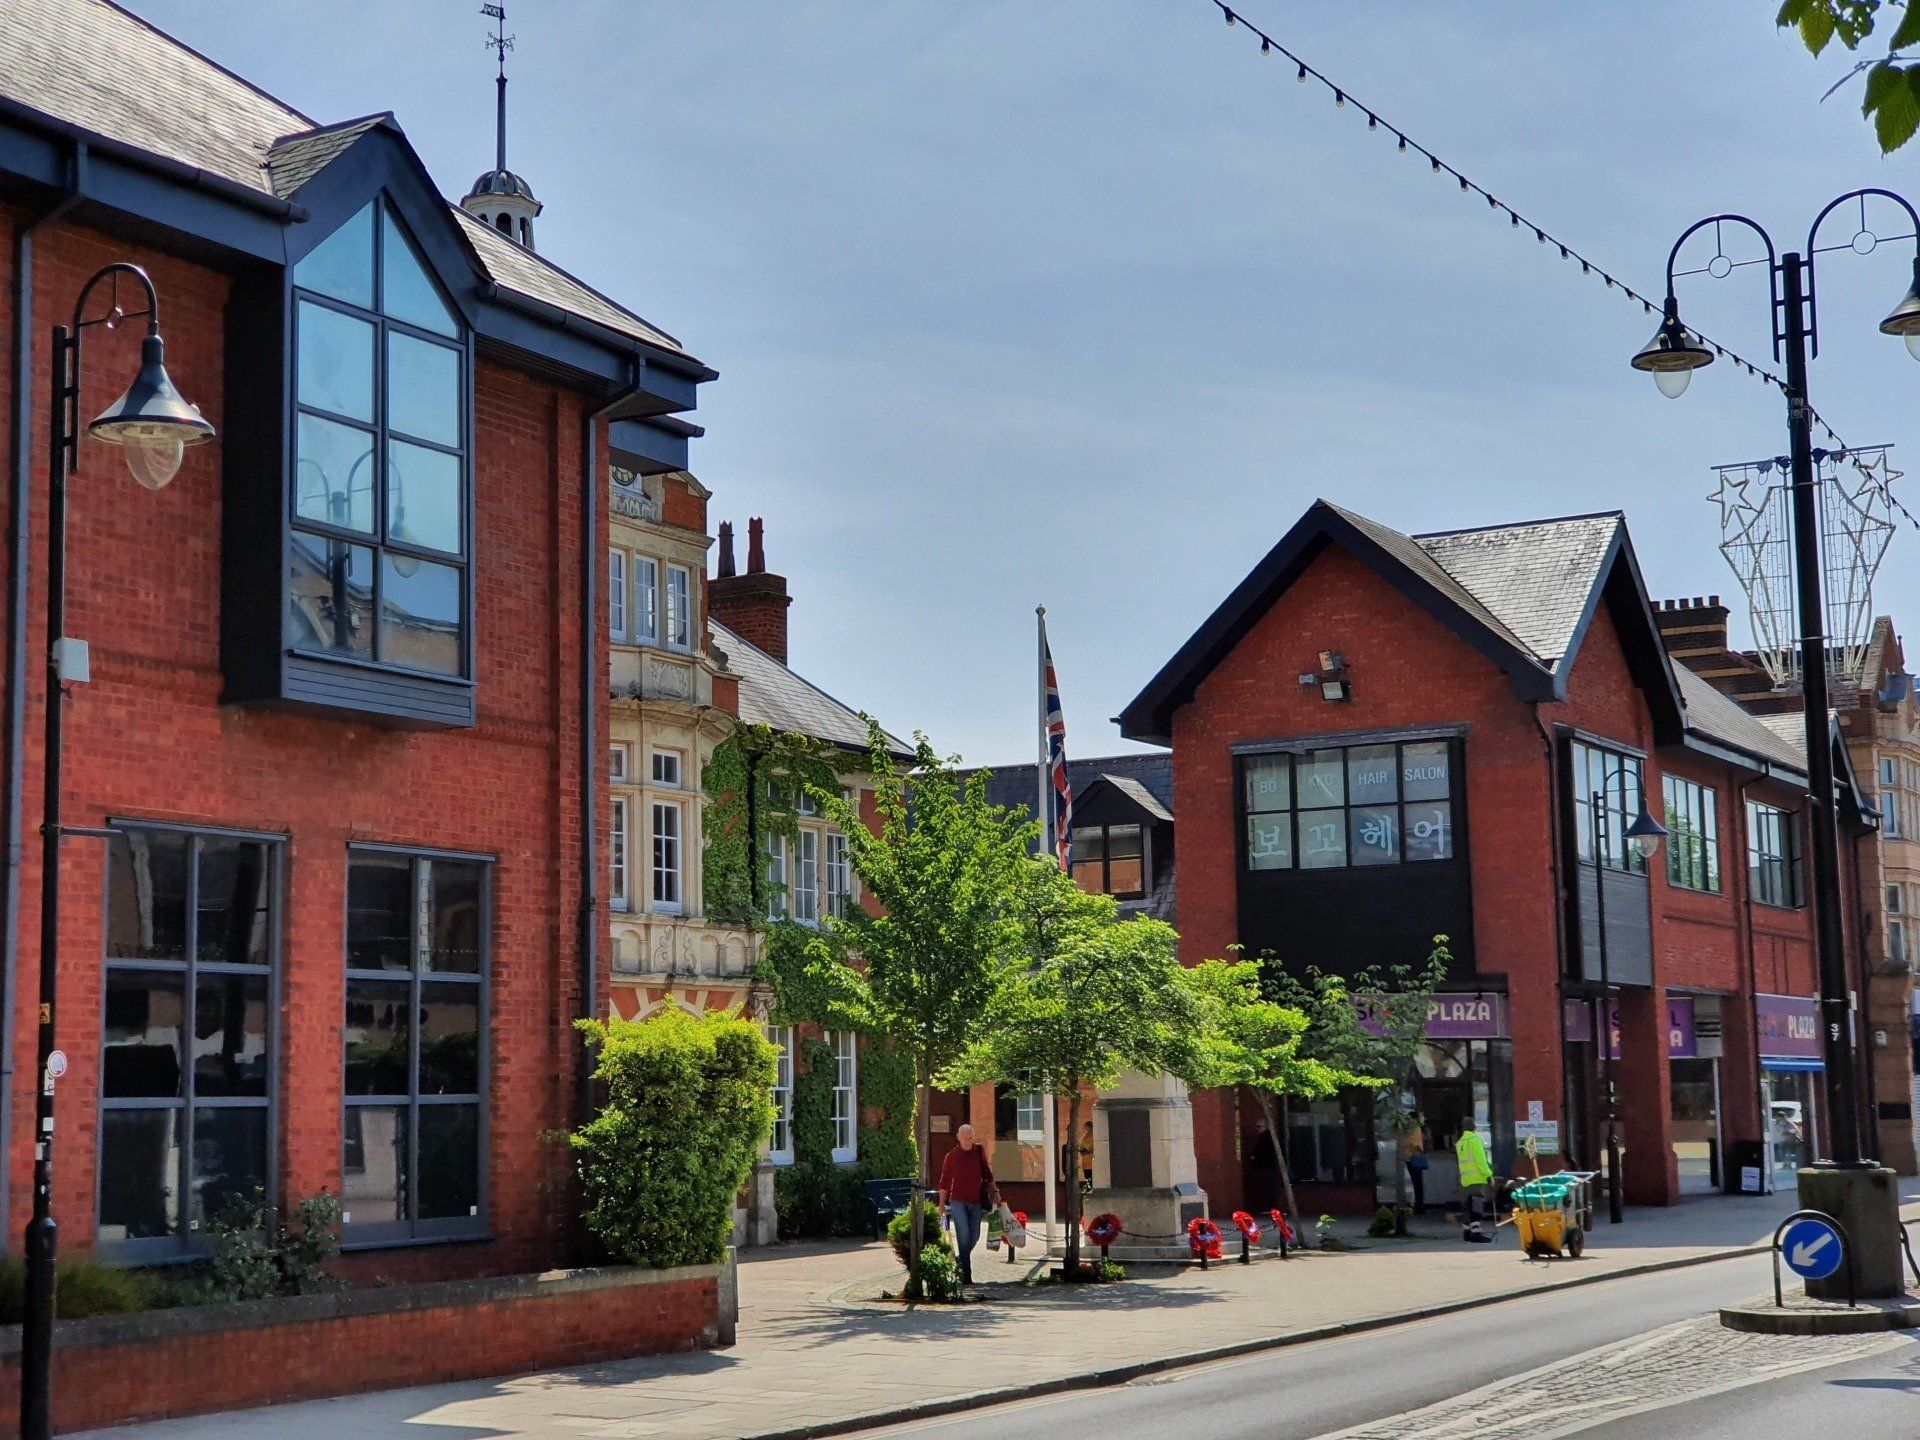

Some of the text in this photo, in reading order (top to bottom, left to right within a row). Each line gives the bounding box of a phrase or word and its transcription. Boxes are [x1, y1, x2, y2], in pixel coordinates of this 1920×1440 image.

[1358, 771, 1388, 785] HAIR
[1404, 766, 1446, 782] SALON
[1427, 1002, 1491, 1021] PLAZA
[1788, 1014, 1816, 1039] PLAZA
